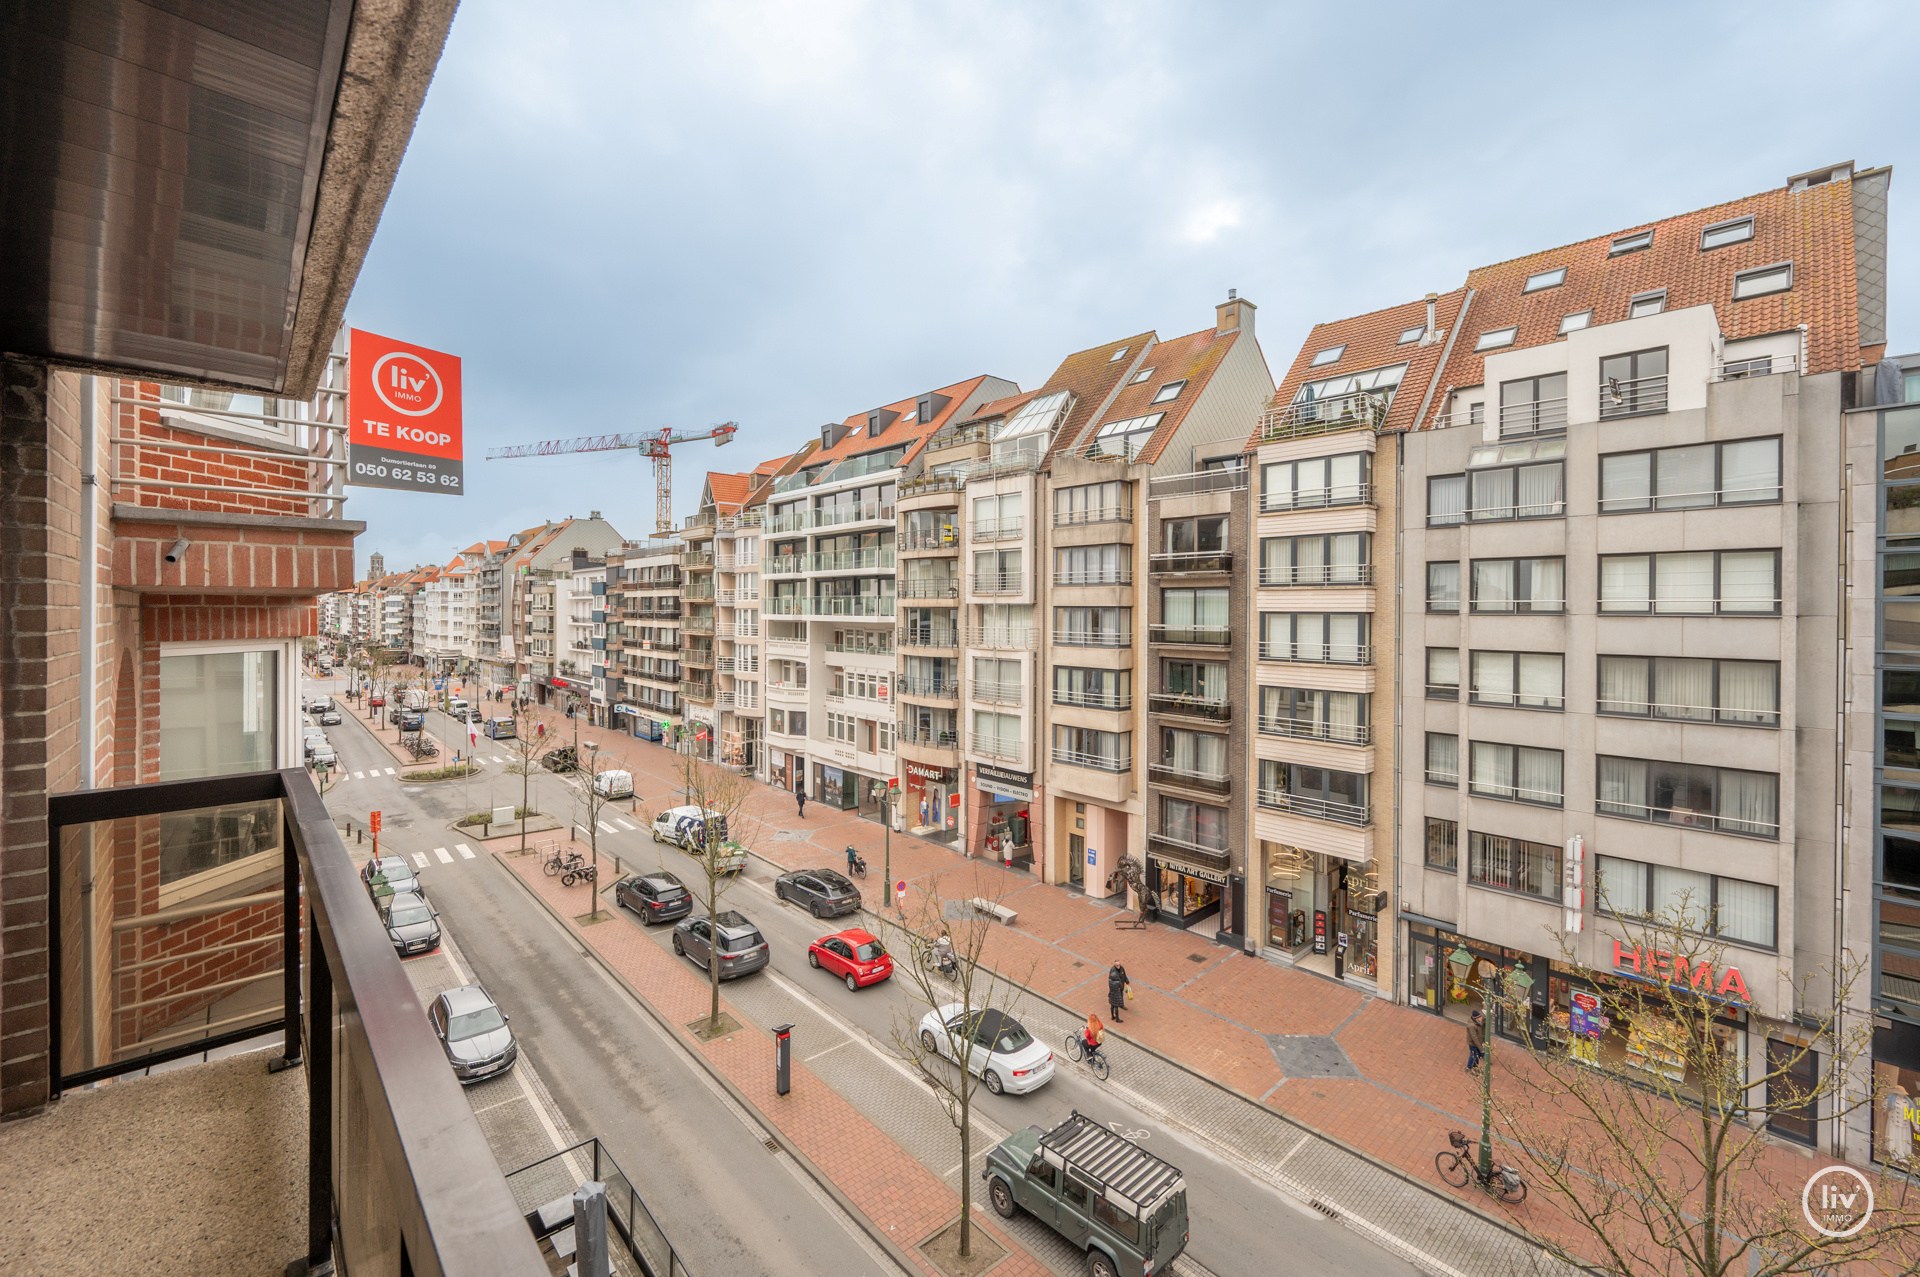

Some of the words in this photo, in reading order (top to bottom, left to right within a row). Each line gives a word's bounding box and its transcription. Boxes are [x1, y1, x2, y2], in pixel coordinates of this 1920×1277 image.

[394, 391, 422, 403] IMMO
[363, 419, 390, 437] TE
[396, 425, 451, 446] KOOP
[355, 462, 387, 477] 050
[391, 469, 412, 481] 62
[416, 471, 436, 484] 53
[440, 474, 459, 487] 62
[906, 764, 941, 780] DAMART
[1169, 862, 1186, 873] NITRA
[1187, 867, 1198, 876] ART
[1199, 871, 1226, 884] GALLERY
[1613, 939, 1751, 1002] HEMA
